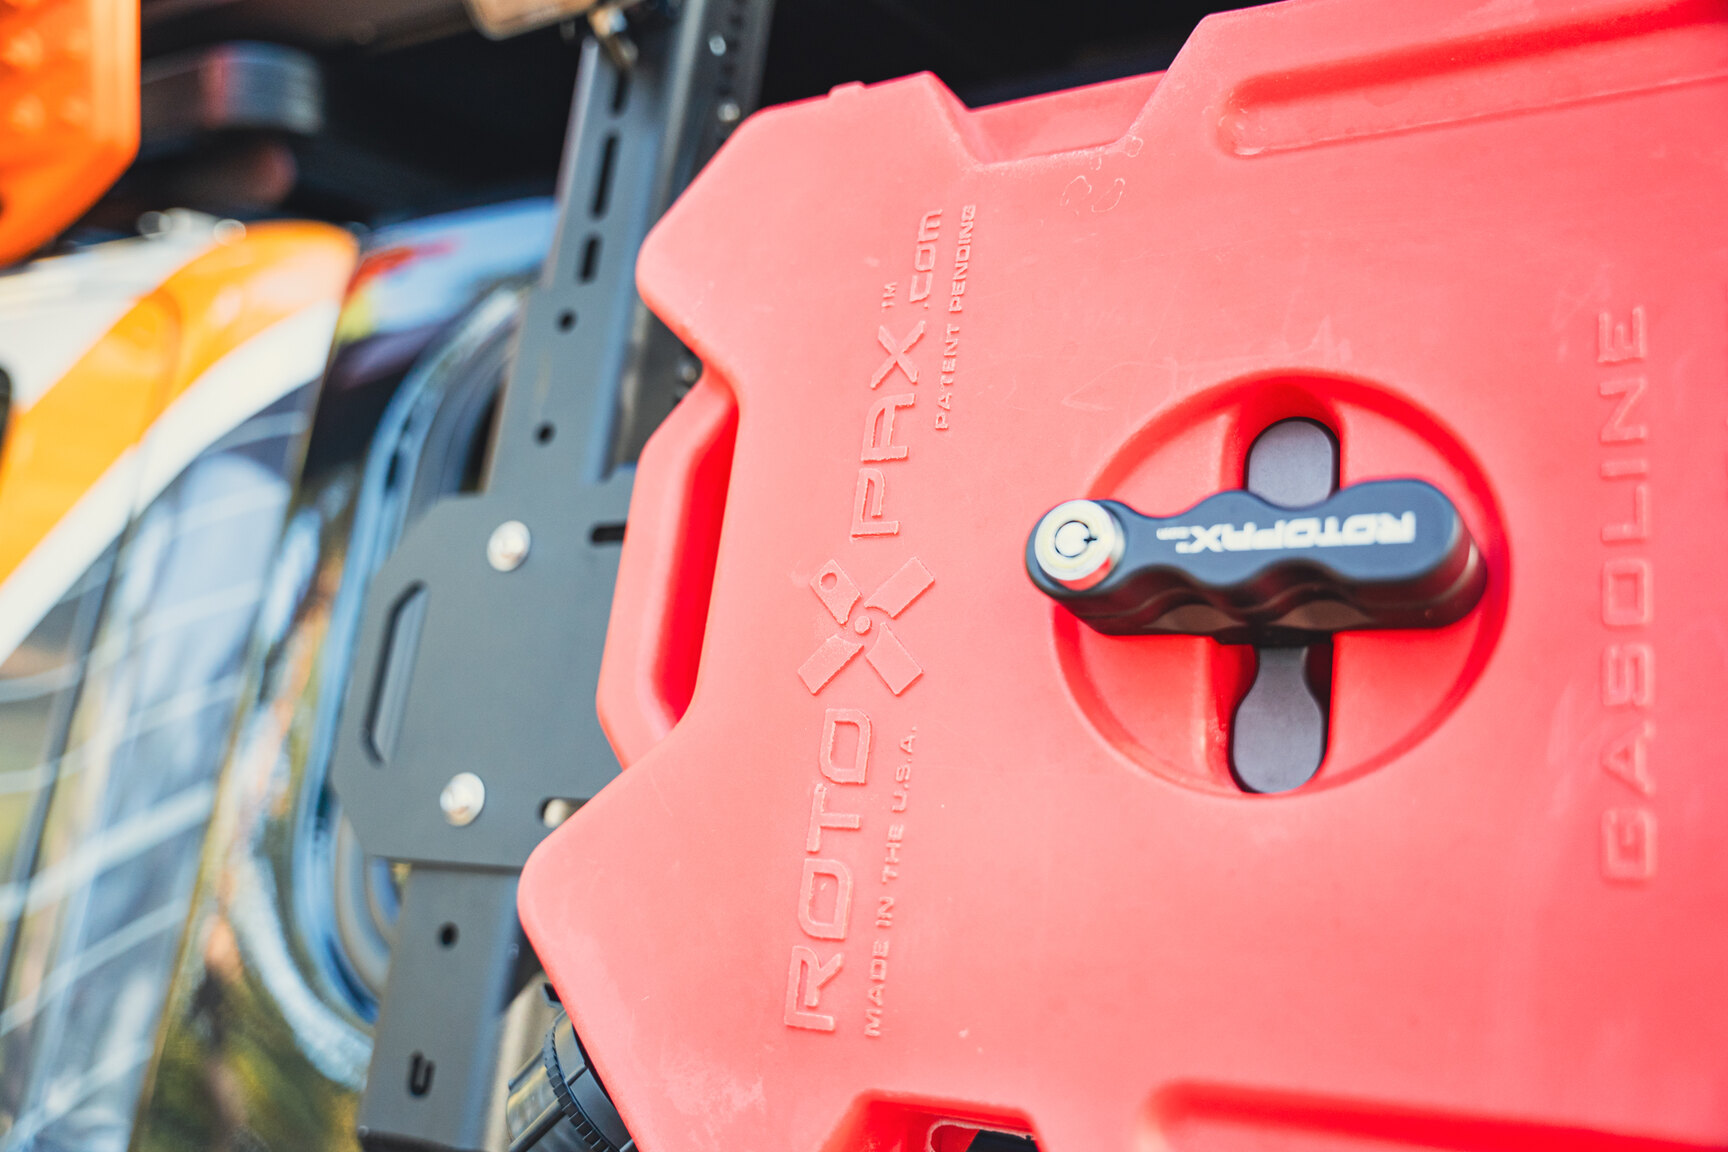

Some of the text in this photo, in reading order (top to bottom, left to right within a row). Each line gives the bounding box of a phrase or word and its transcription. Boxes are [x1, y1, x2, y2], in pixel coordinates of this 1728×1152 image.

[935, 204, 976, 431] PATENT PENDING
[784, 320, 926, 1033] ROTO PAX
[1188, 511, 1417, 555] ROTOPAX
[1598, 305, 1656, 885] GASOLINE
[865, 725, 917, 1038] MADE IN THE U.S.A.
